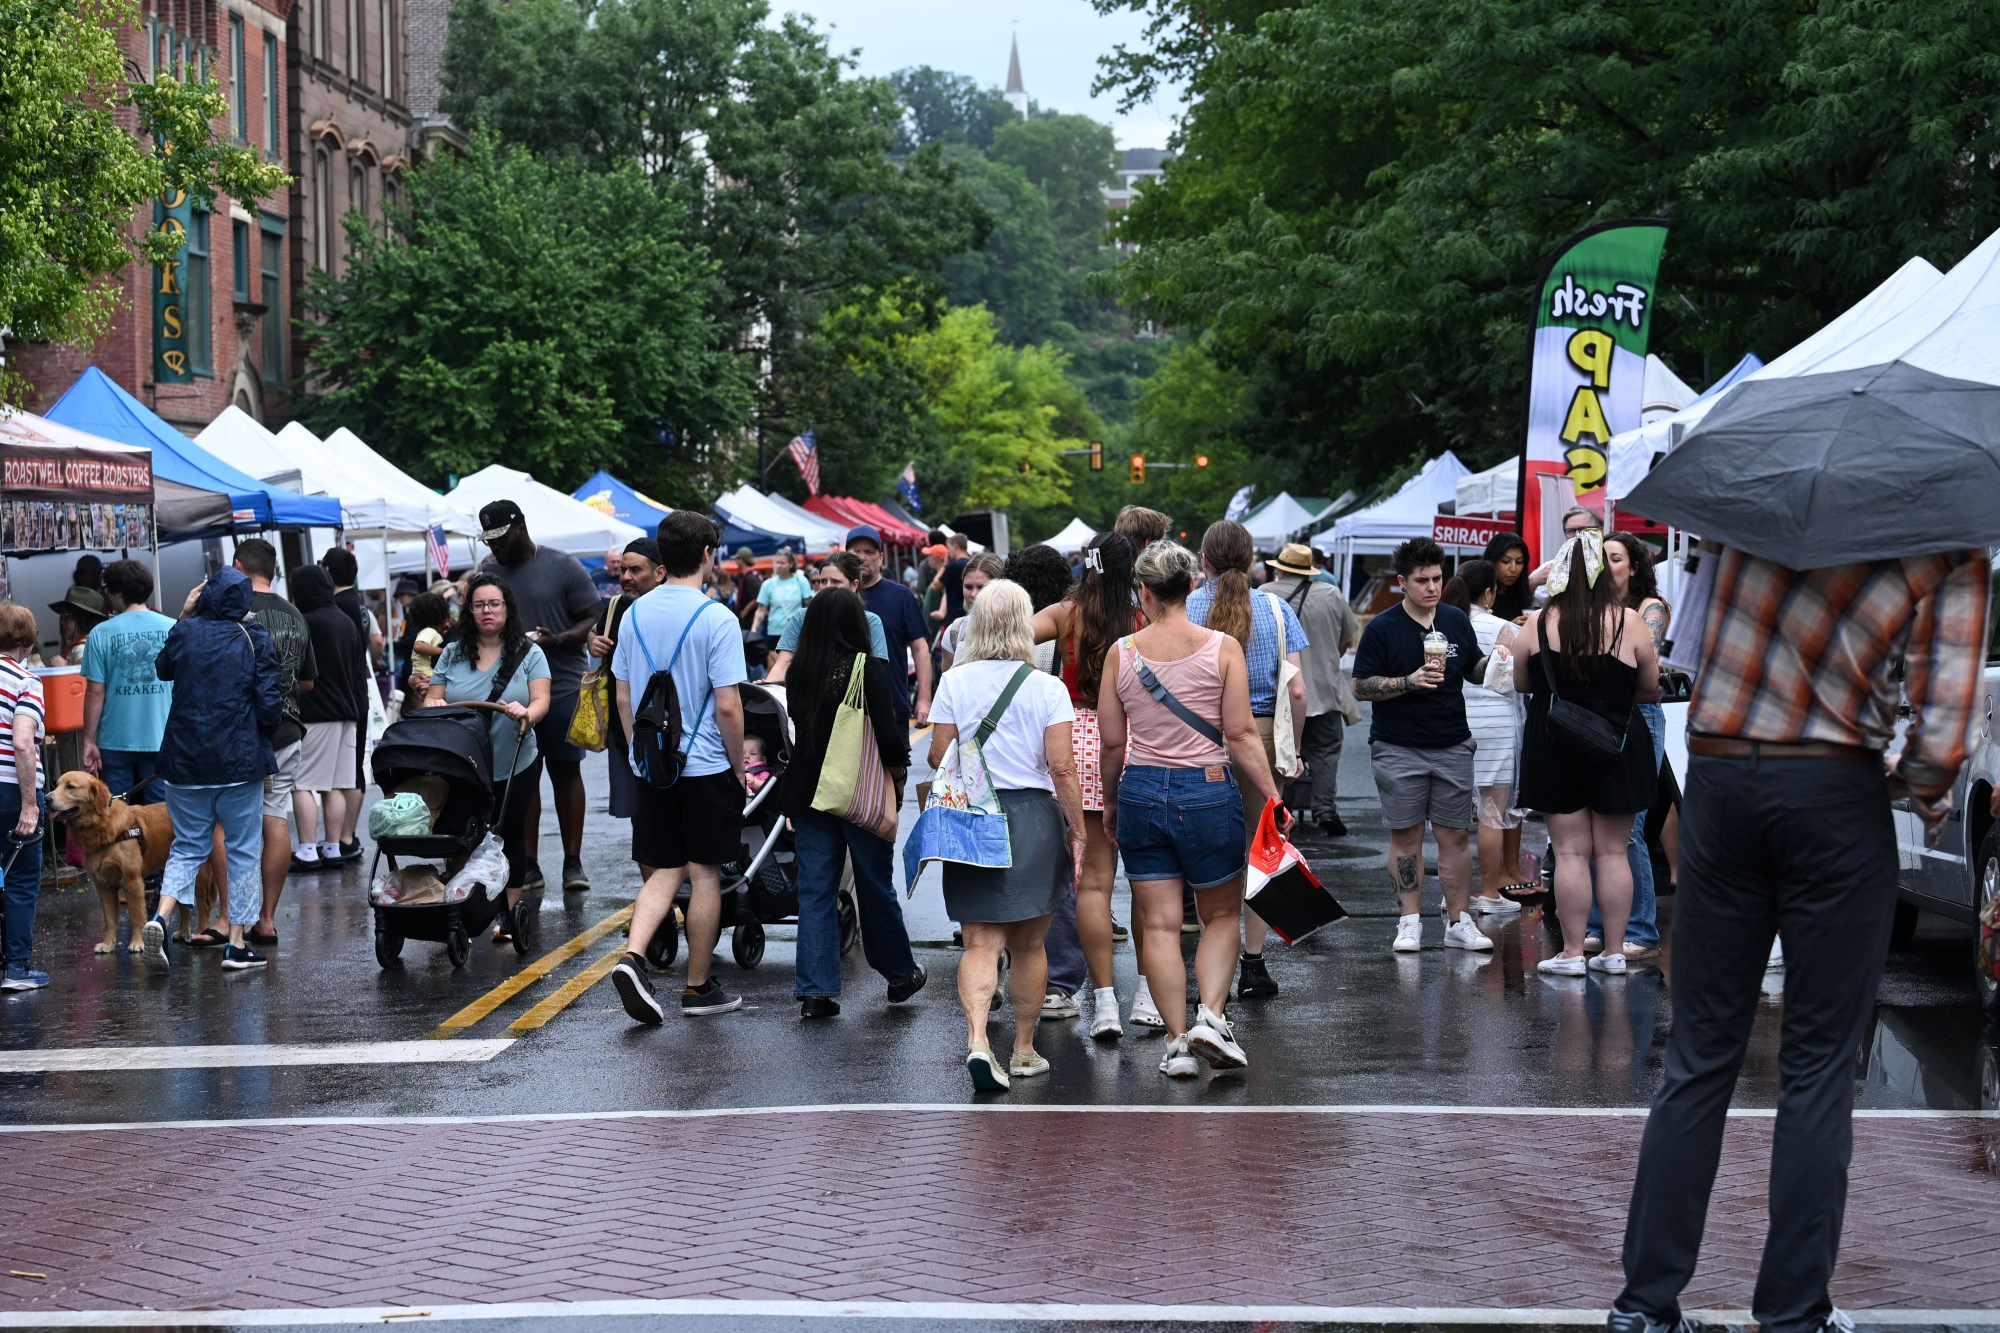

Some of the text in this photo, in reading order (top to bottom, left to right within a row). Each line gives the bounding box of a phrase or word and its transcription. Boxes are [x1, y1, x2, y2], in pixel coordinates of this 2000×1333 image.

[159, 138, 187, 340] OOKS
[4, 461, 150, 487] ROASTWELL COFFEE ROASTERS
[109, 631, 153, 652] RELEASE
[115, 683, 166, 696] KRAKEN
